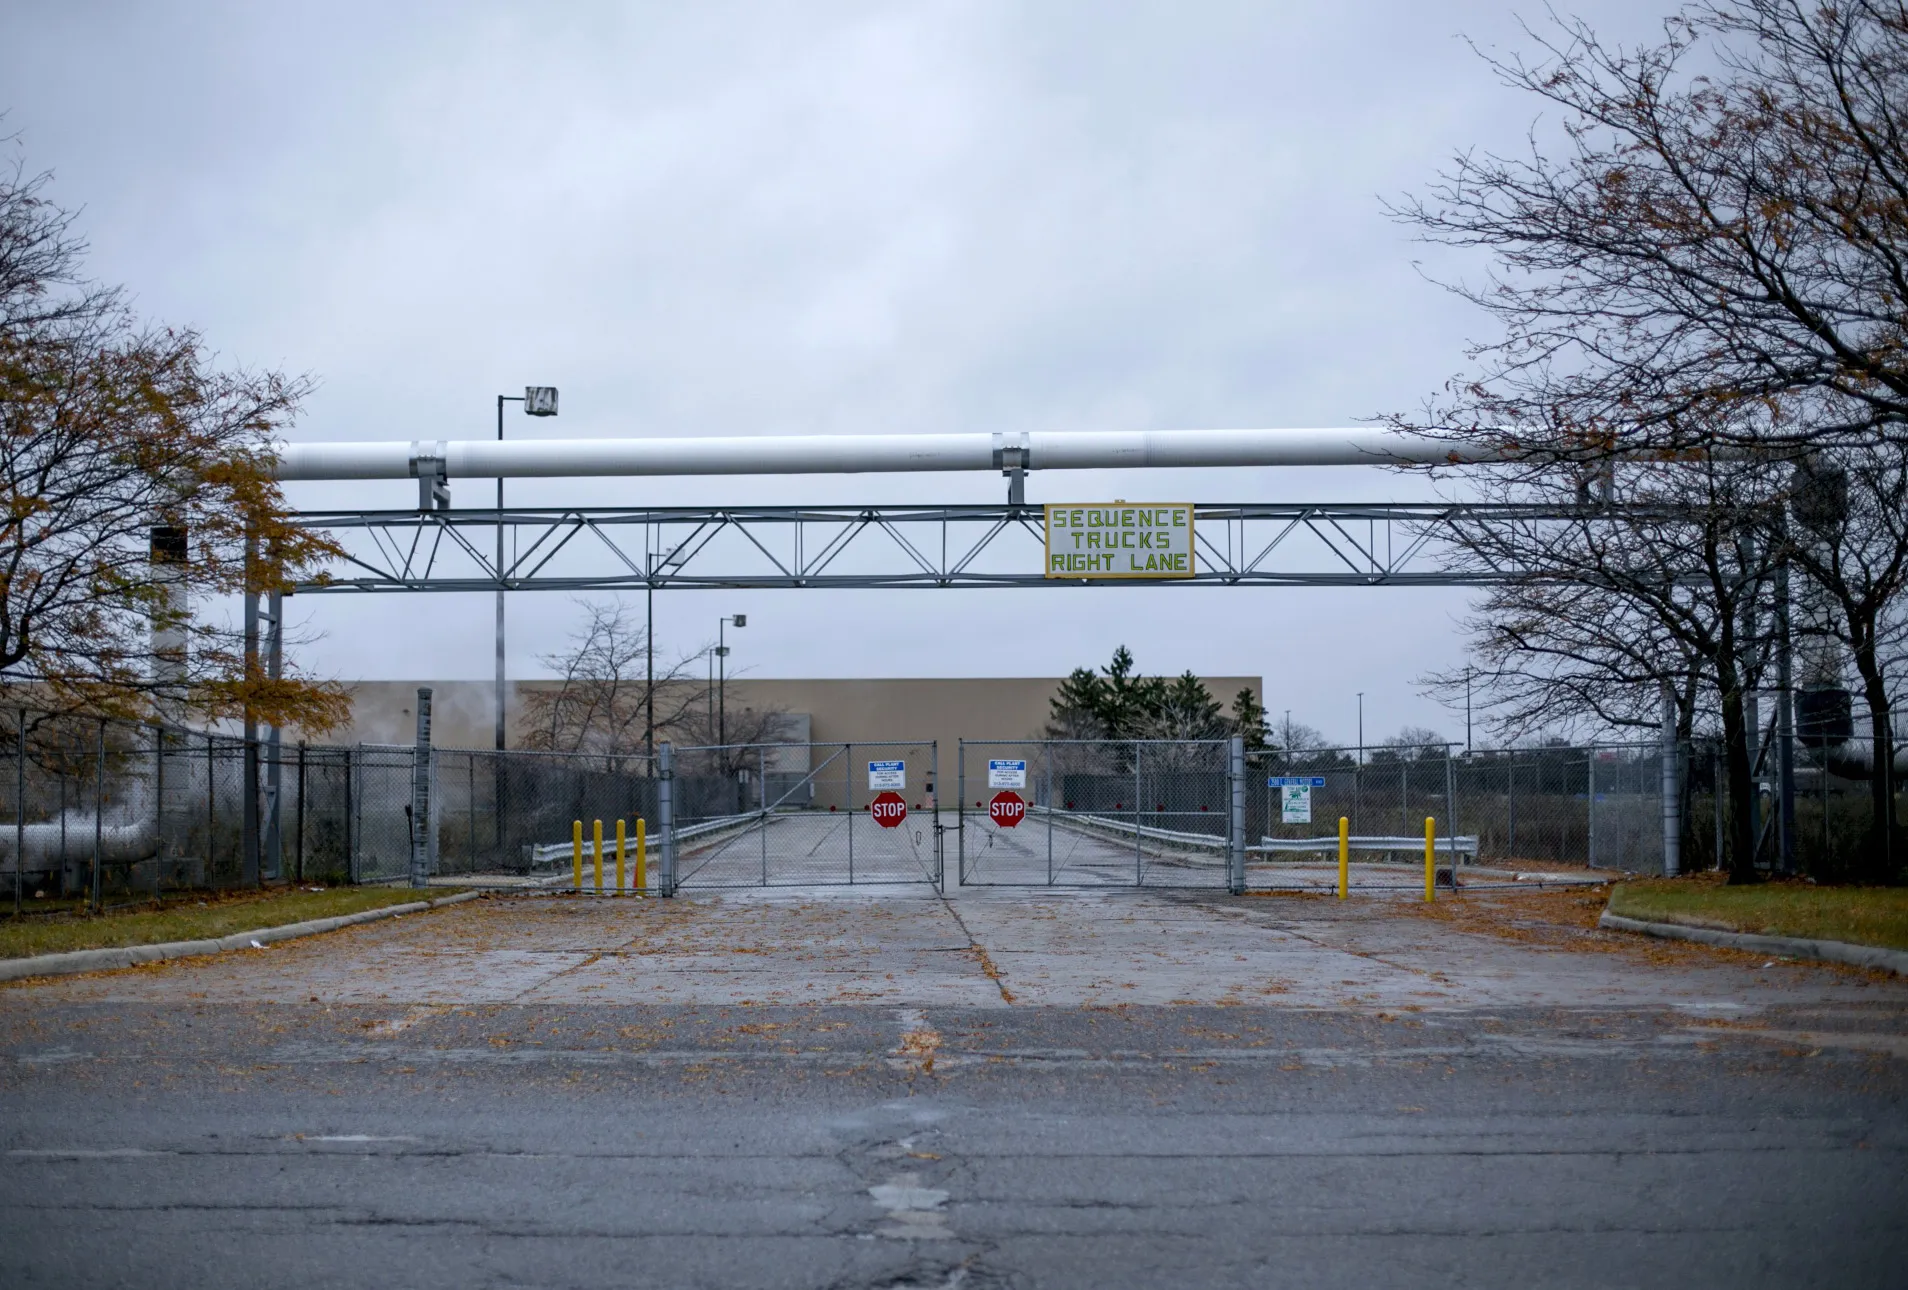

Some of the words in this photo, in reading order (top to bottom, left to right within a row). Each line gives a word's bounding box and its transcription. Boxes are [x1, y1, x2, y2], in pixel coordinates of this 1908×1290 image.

[1053, 510, 1186, 528] SEQUENCE
[1071, 532, 1170, 548] TRUCKS
[1052, 554, 1114, 571] RIGHT
[1130, 554, 1188, 571] LANE
[874, 802, 905, 817] STOP
[992, 802, 1023, 816] STOP
